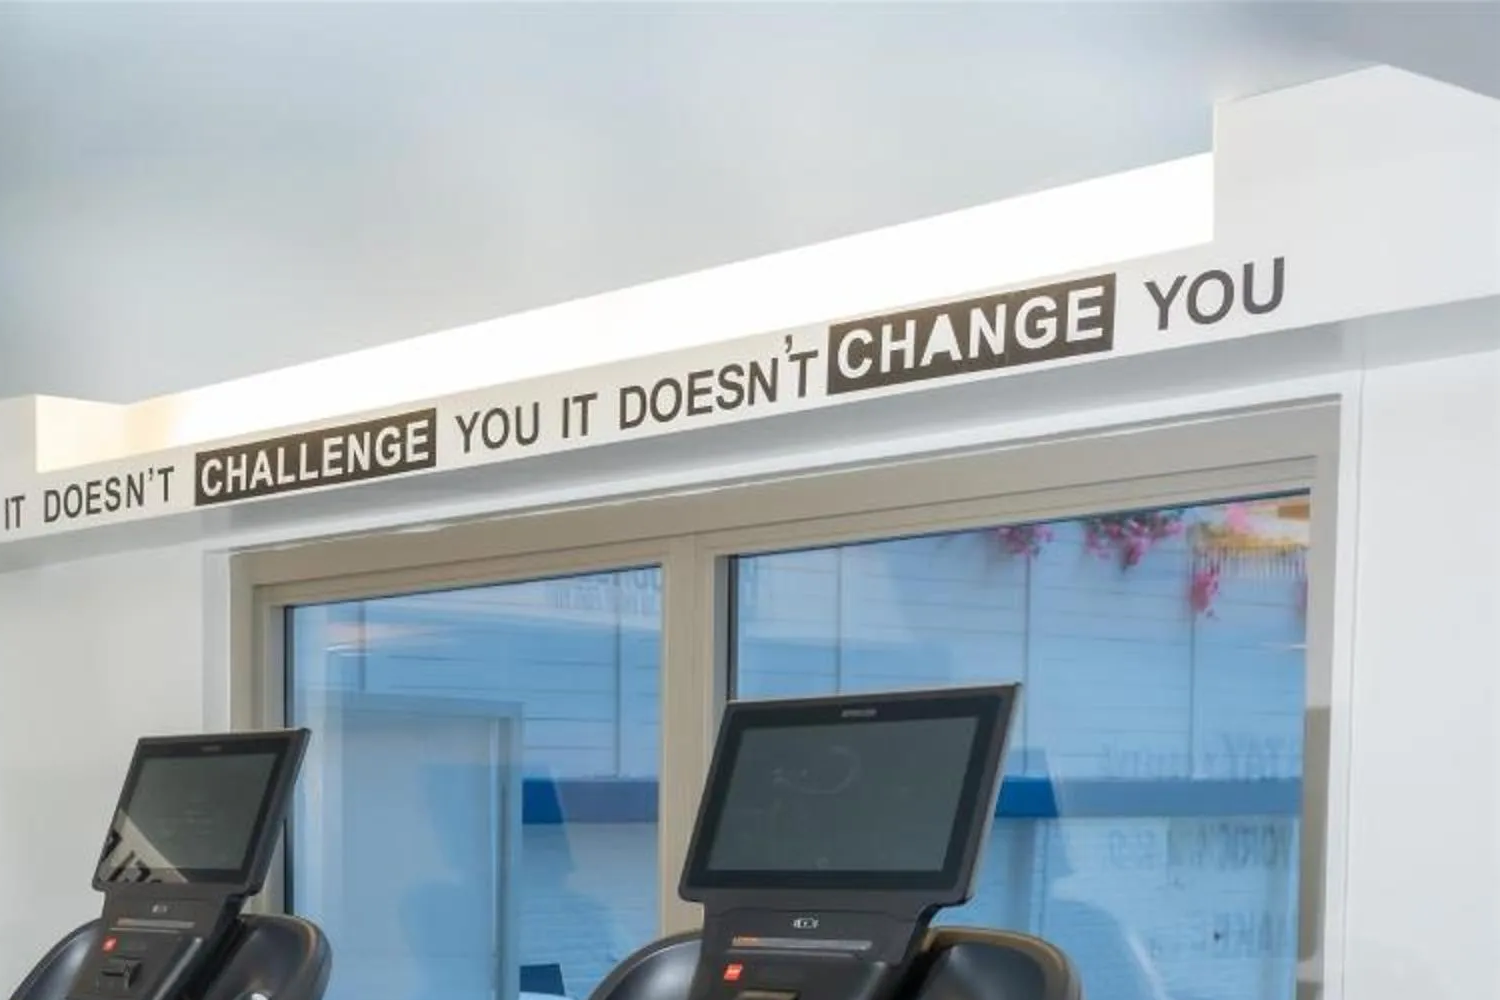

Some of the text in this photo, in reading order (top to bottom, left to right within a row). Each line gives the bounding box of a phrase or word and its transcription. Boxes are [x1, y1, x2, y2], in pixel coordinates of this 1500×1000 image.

[3, 495, 26, 530] IT
[43, 465, 175, 523] DOESN'T
[200, 419, 431, 498] CHALLENGE
[455, 401, 540, 454] YOU
[561, 392, 598, 439] IT
[618, 334, 820, 431] DOESN'T
[837, 285, 1106, 379] CHANGE
[1145, 256, 1286, 331] YOU
